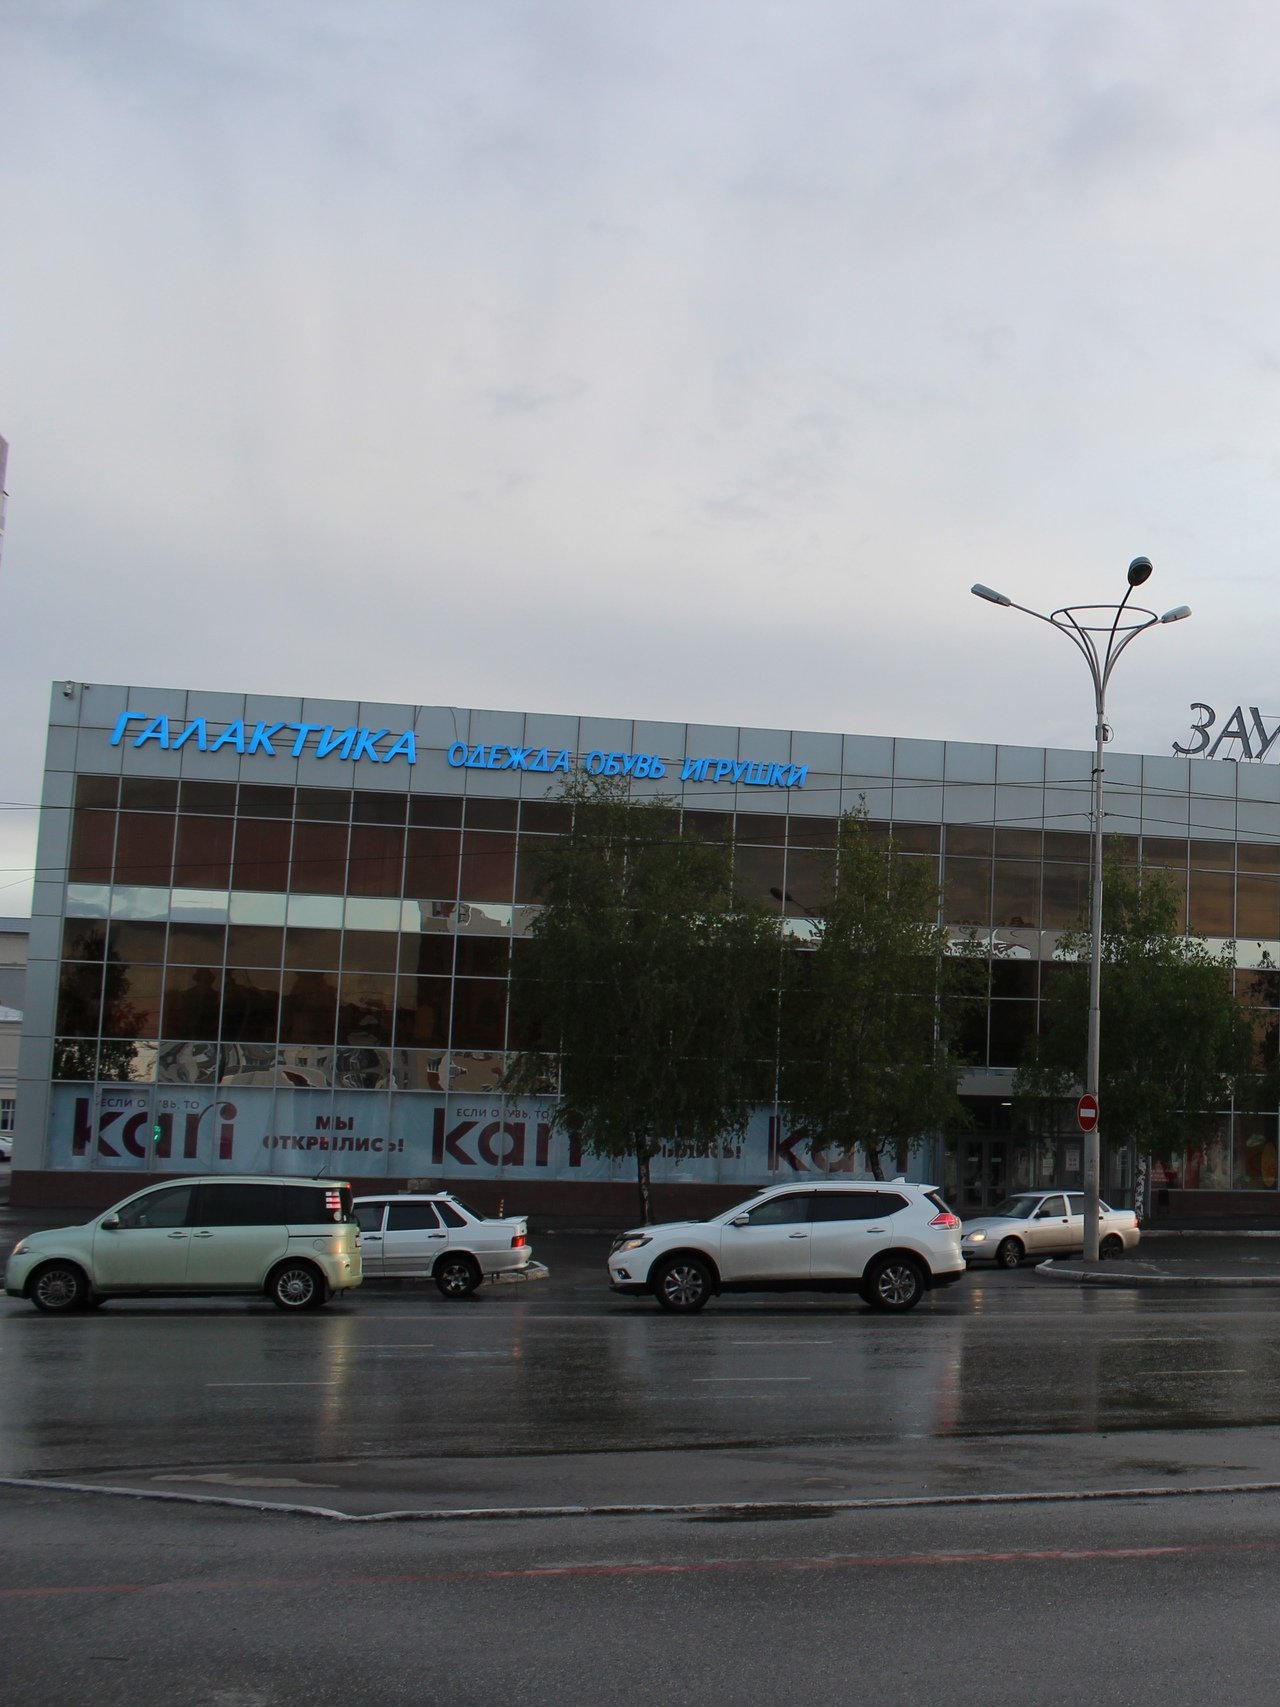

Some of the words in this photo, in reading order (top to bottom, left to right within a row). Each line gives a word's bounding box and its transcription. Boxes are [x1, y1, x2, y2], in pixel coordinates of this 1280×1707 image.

[108, 710, 418, 765] ГАЛАКТИКА
[446, 740, 571, 774] ОДЕЖДА
[585, 748, 666, 780] ОБУВЬ
[680, 756, 810, 788] ИГРУШКИ
[101, 1098, 132, 1108] ЕСЛИ
[184, 1100, 200, 1110] ТО
[456, 1108, 487, 1117] ЕСЛИ
[491, 1109, 531, 1119] ОУВЬ,
[72, 1098, 238, 1159] kari
[315, 1116, 354, 1130] МЫ
